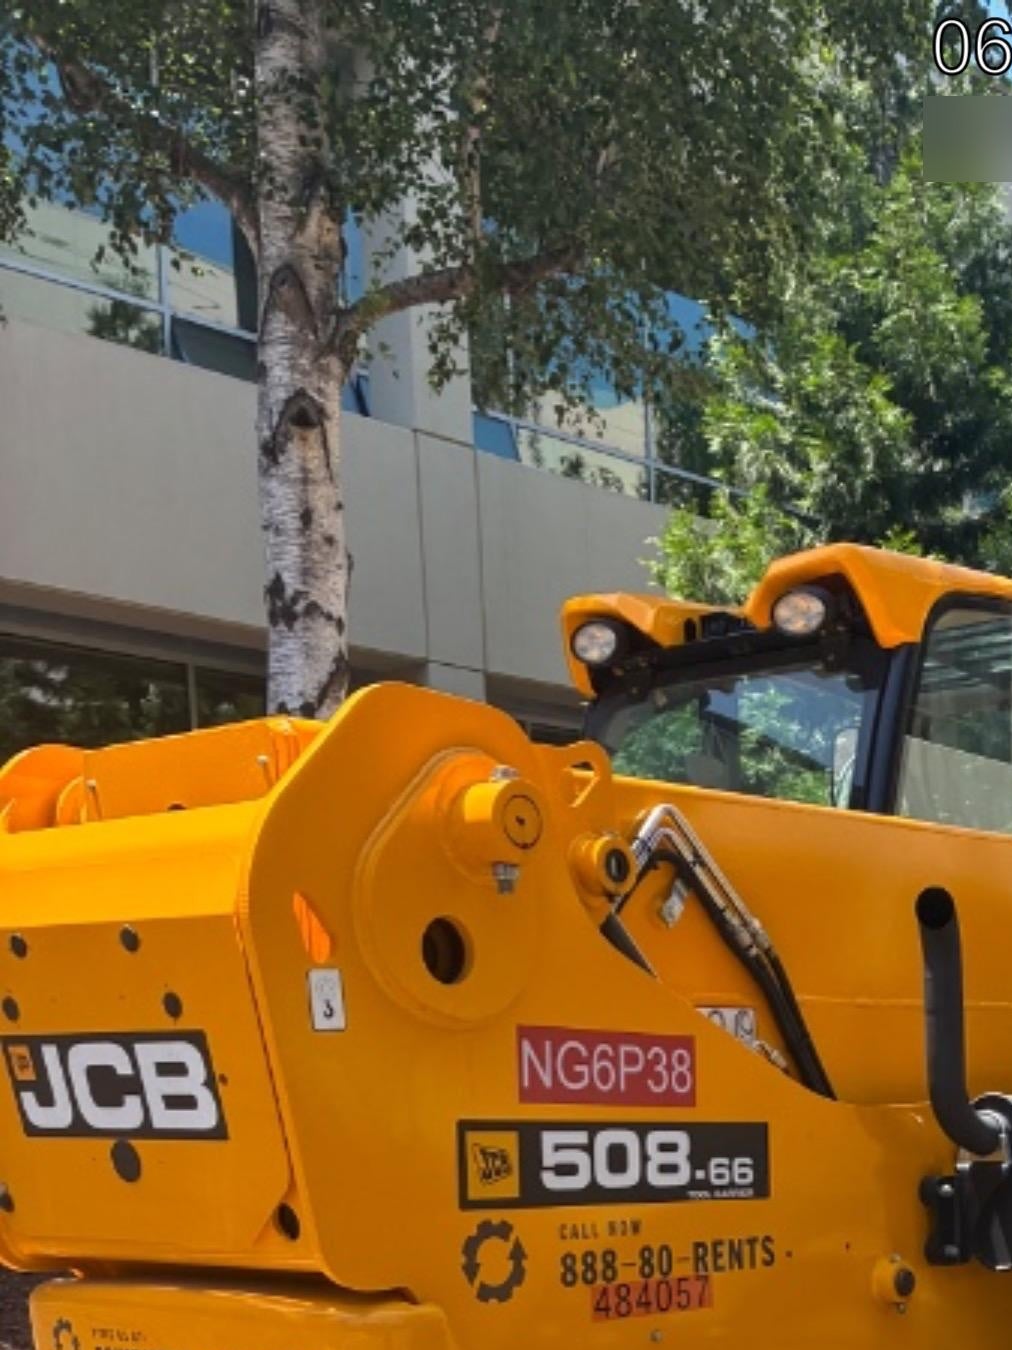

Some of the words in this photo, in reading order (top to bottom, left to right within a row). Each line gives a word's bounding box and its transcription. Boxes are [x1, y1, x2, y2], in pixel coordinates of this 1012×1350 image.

[20, 1040, 219, 1130] JCB
[520, 1039, 692, 1093] NG6P38
[559, 1222, 599, 1241] CALL
[607, 1219, 642, 1237] NOW
[594, 1275, 711, 1319] 484057
